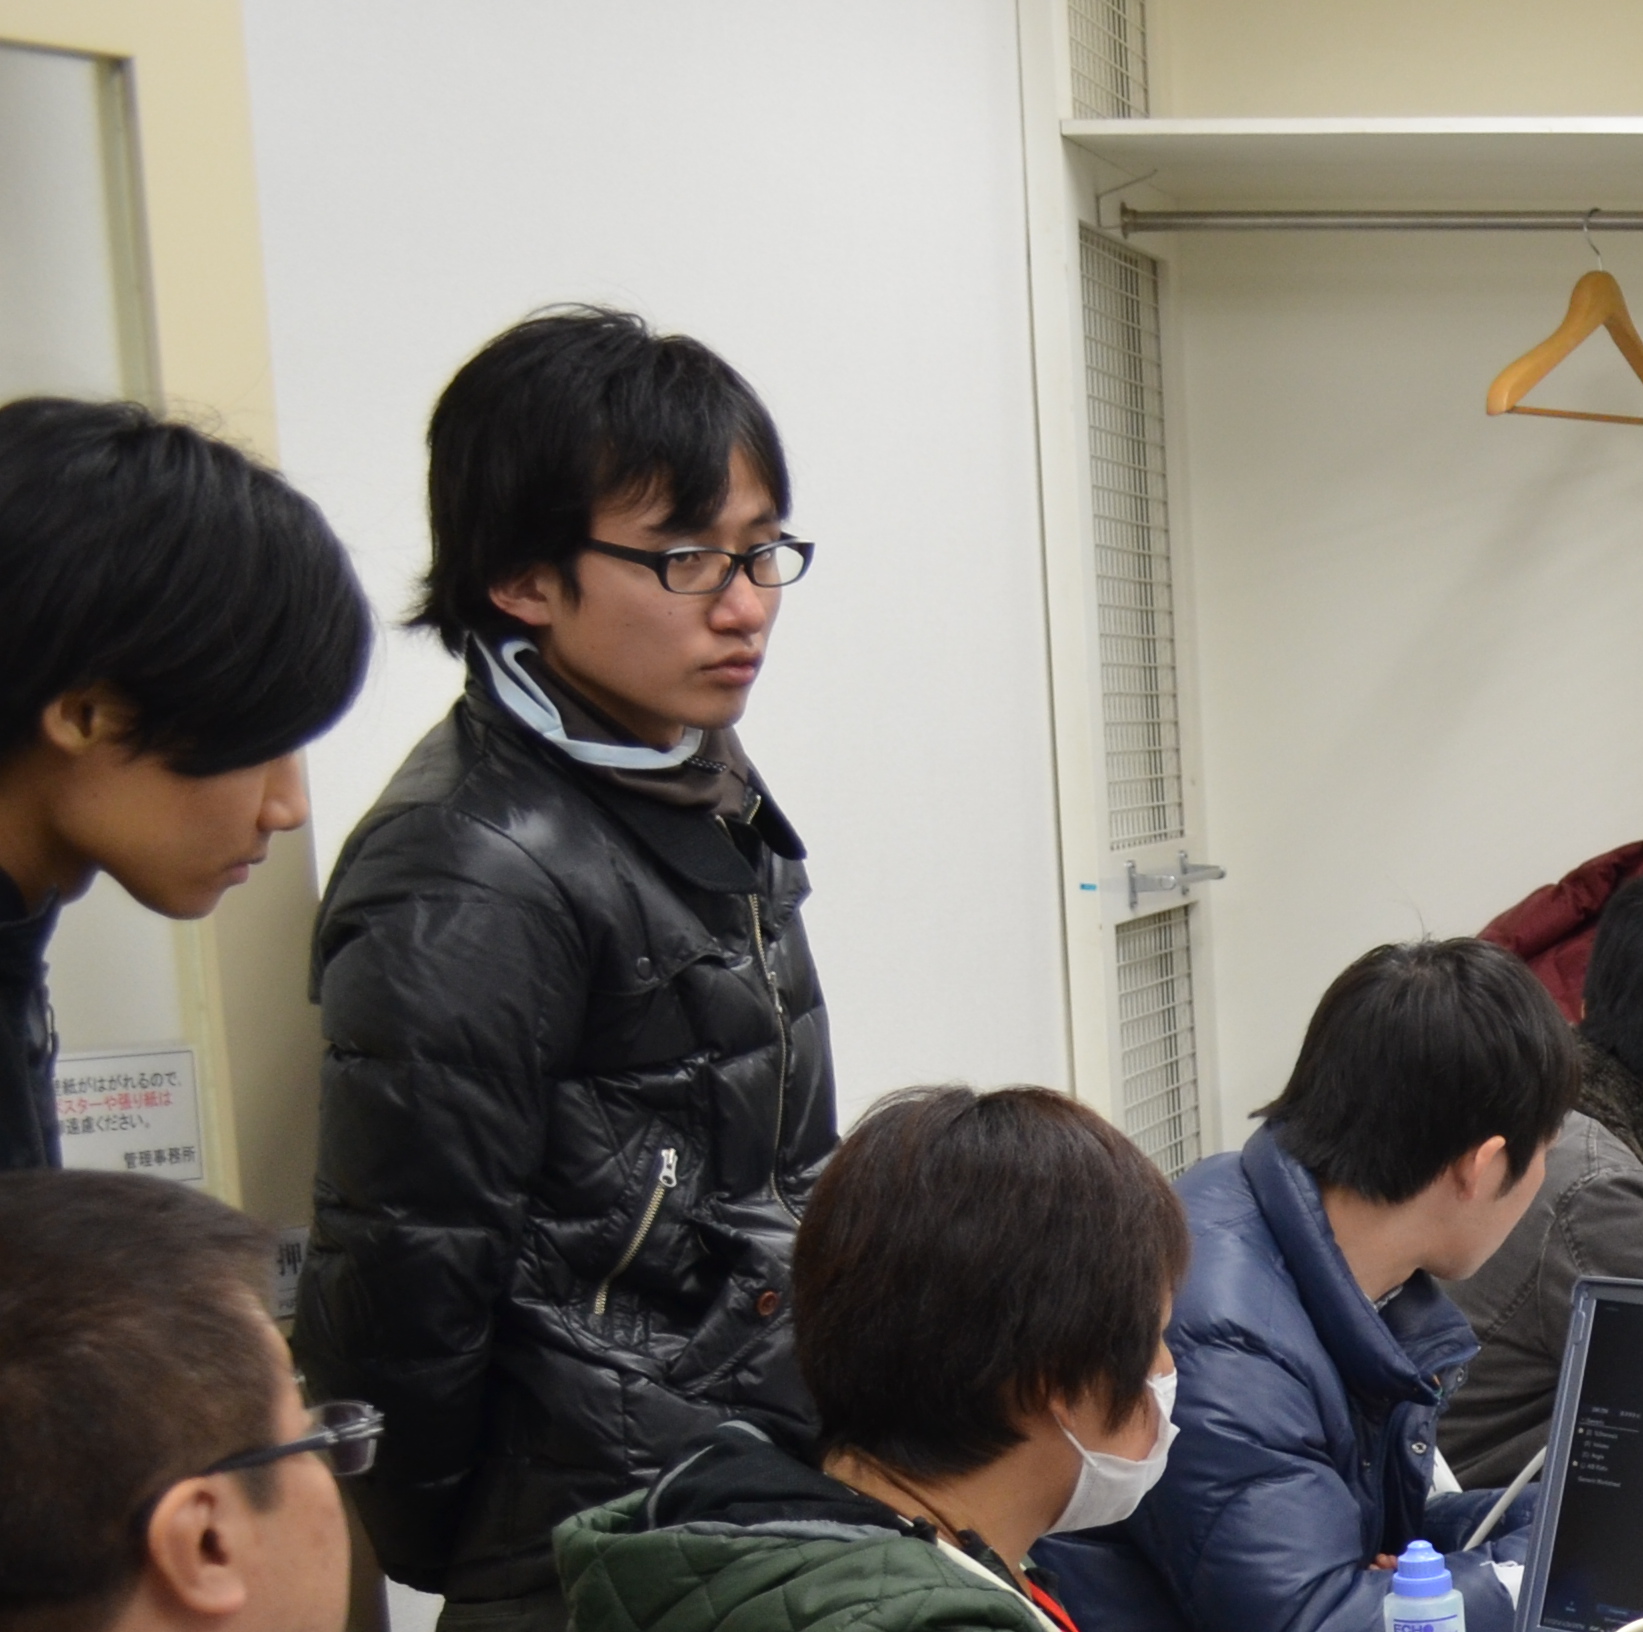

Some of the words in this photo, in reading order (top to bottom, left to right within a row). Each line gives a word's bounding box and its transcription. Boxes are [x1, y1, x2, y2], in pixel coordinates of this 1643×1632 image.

[124, 1146, 196, 1169] 管理事務所
